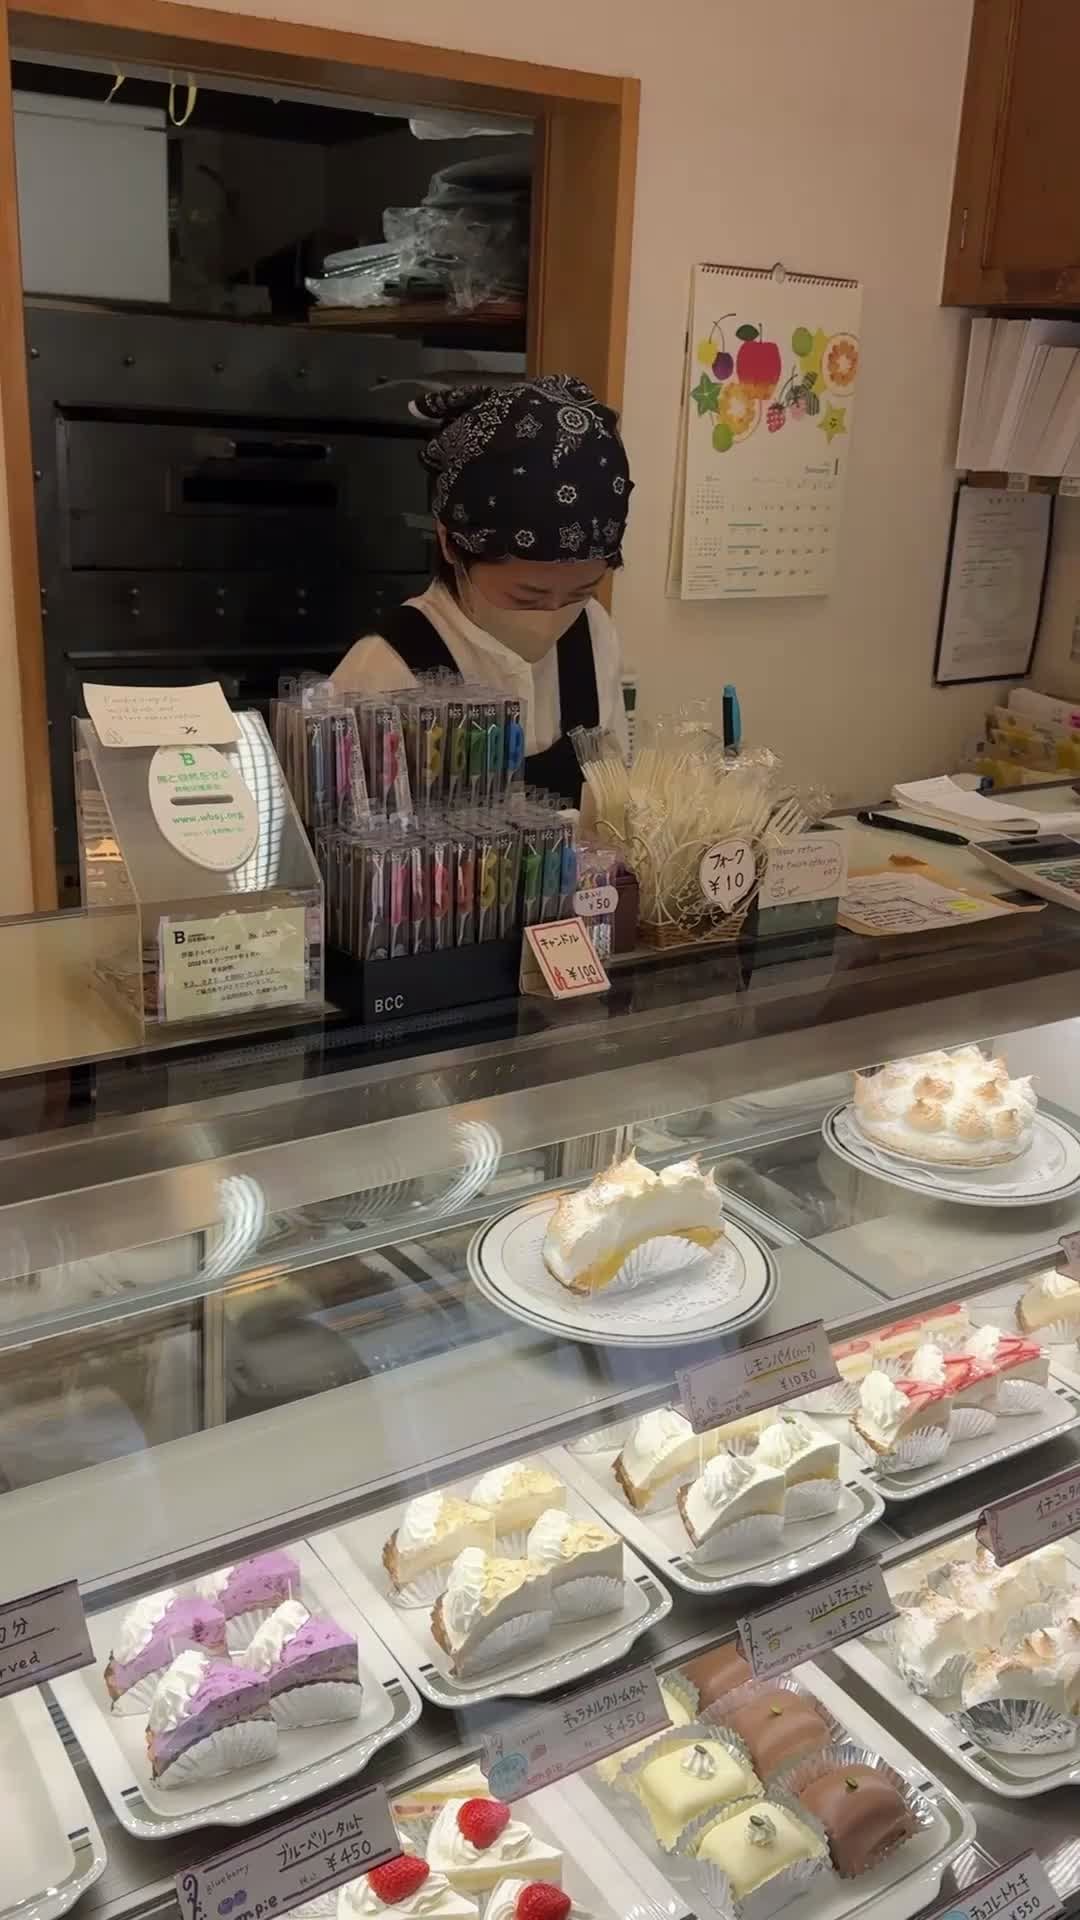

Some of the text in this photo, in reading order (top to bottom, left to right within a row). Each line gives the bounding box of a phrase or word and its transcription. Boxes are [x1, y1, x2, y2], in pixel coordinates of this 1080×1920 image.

[709, 849, 745, 870] フォーク
[708, 872, 744, 896] ¥10
[173, 931, 186, 945] B
[540, 933, 580, 950] キャンドル
[566, 964, 597, 981] ¥100
[374, 994, 404, 1013] BCC
[779, 1369, 817, 1390] ¥1080
[841, 1607, 873, 1630] ¥500
[603, 1711, 647, 1740] ¥450
[276, 1813, 364, 1867] ブルーベリータルト
[324, 1839, 372, 1873] ¥450
[969, 1872, 1030, 1920] チョコレートケーキ
[1008, 1896, 1040, 1920] ¥550
